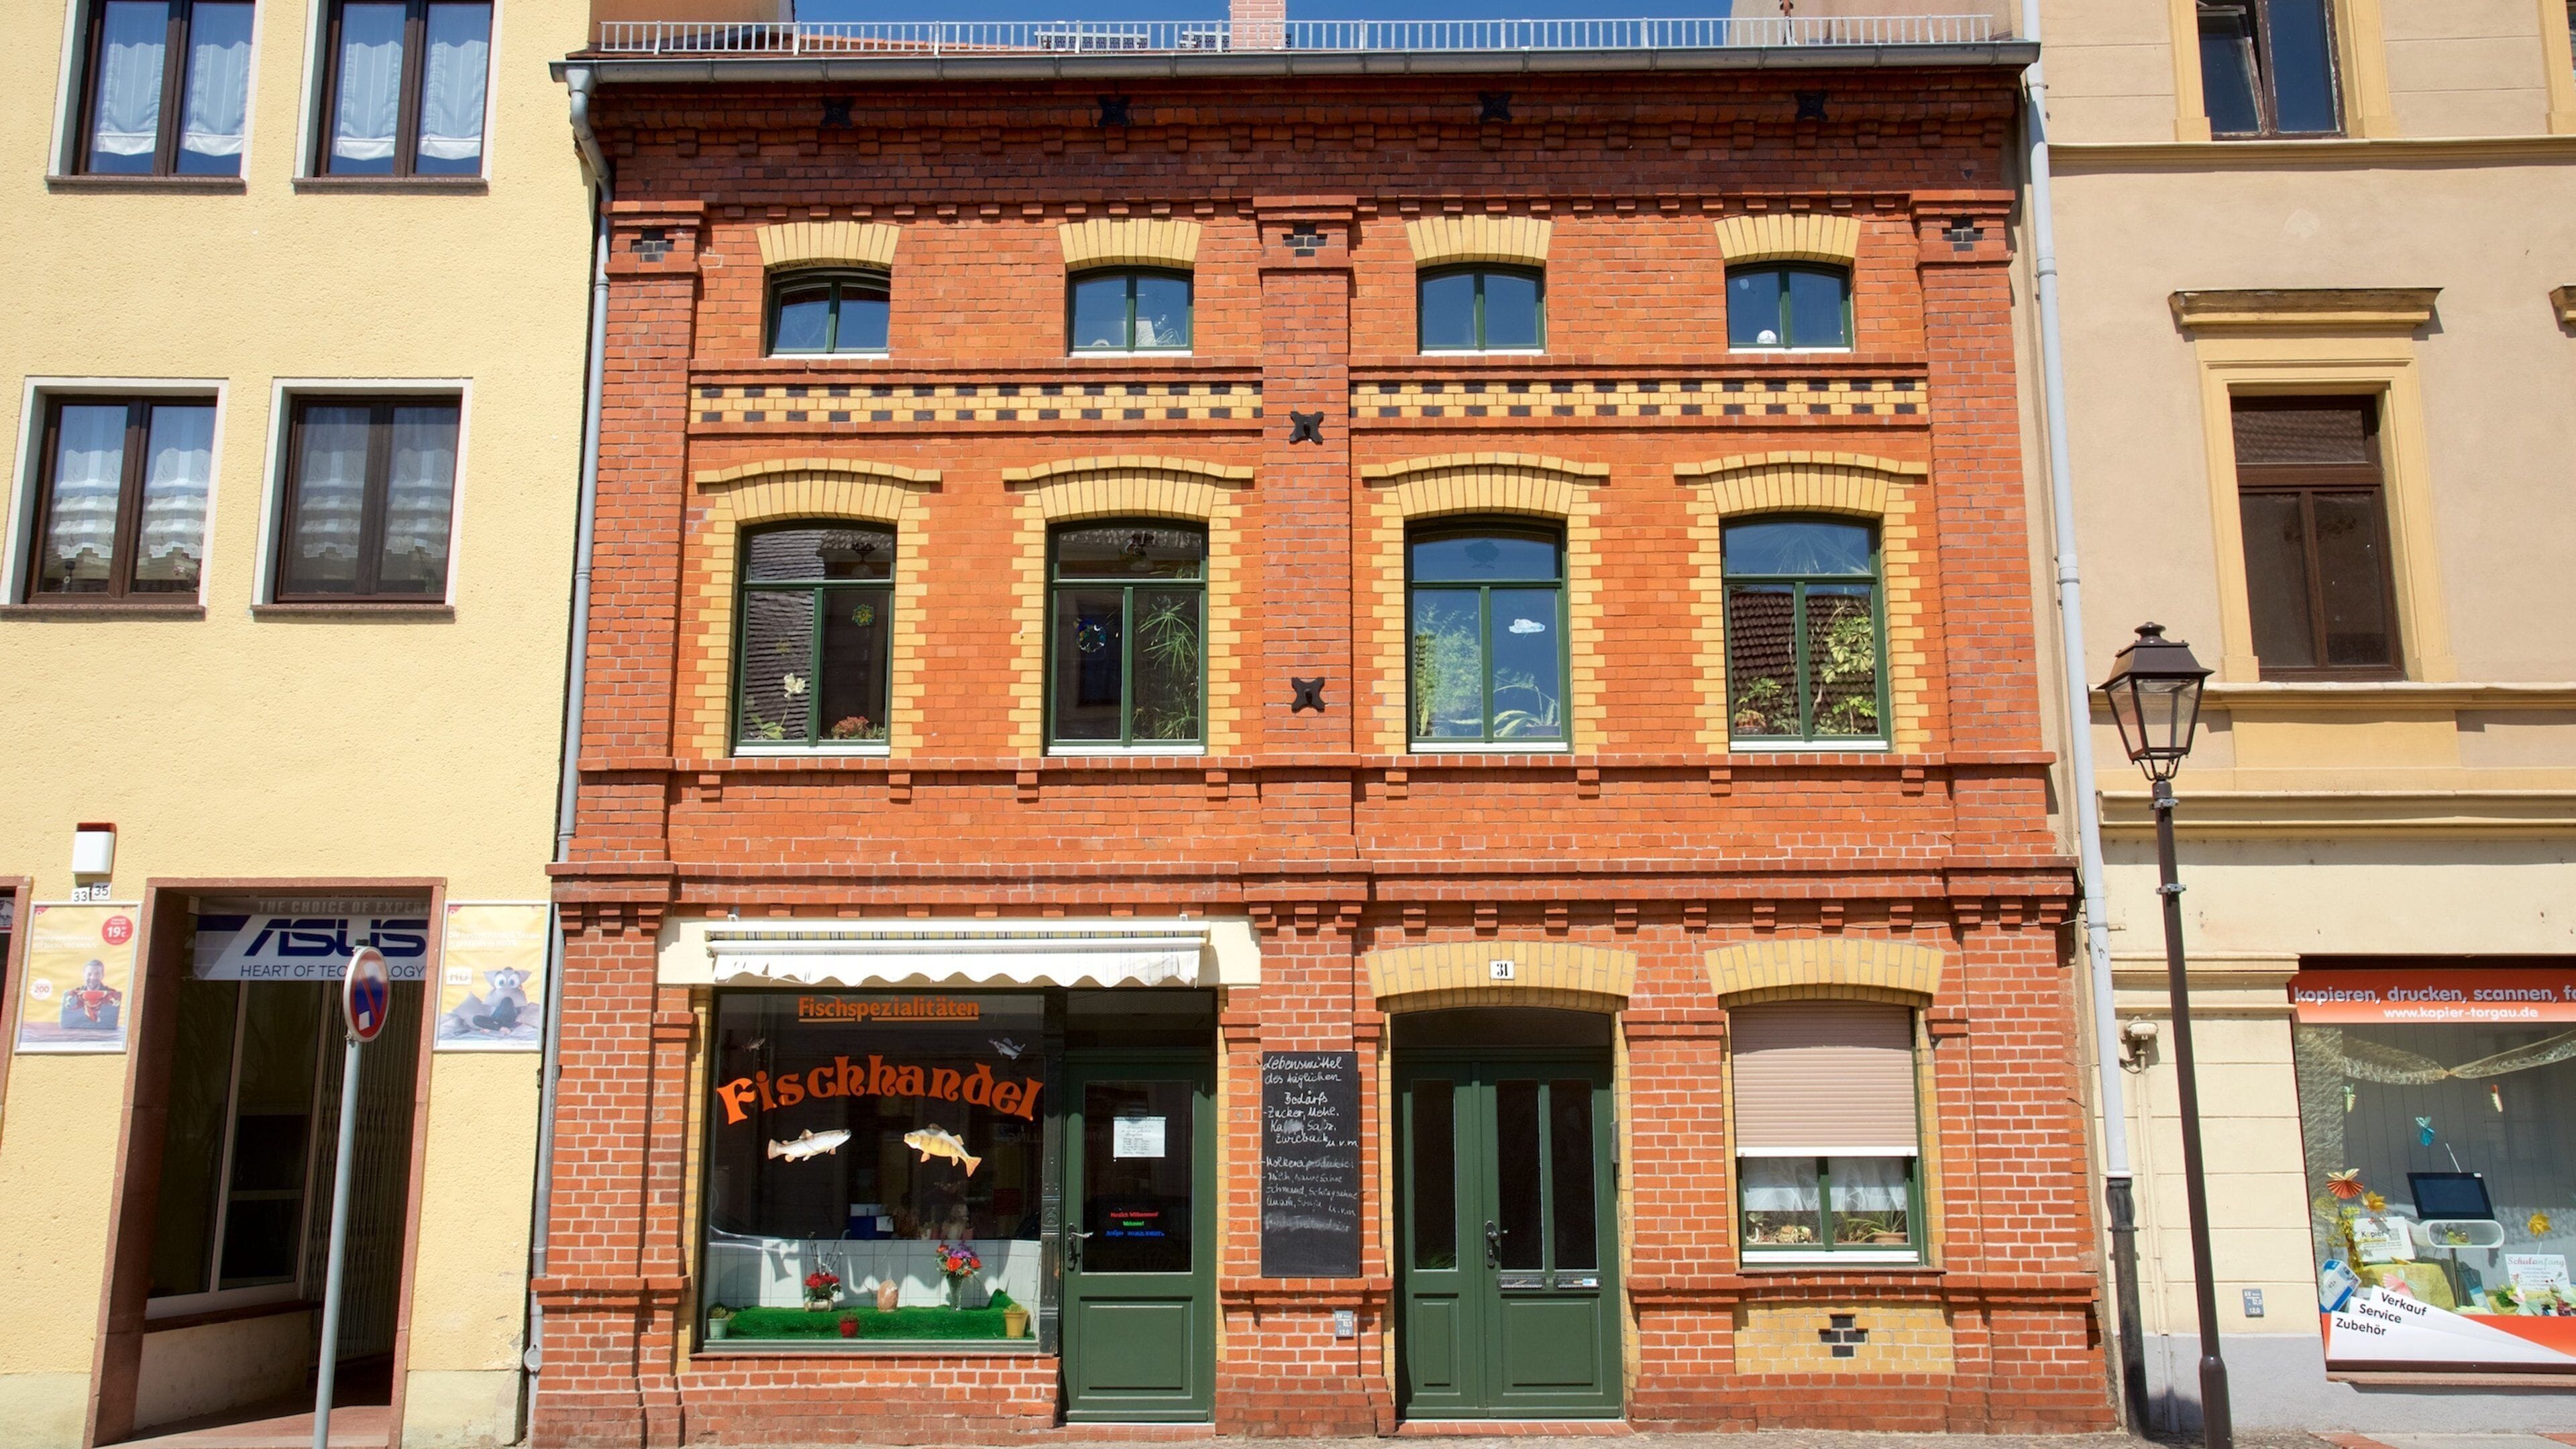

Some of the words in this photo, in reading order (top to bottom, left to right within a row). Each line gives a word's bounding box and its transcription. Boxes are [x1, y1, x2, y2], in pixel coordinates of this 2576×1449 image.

[74, 891, 87, 902] 33
[95, 885, 109, 896] 35
[259, 900, 284, 913] THE
[291, 900, 344, 913] CHOICE
[352, 900, 371, 913] OF
[244, 918, 428, 957] ASUS
[240, 965, 290, 977] HEART
[294, 965, 315, 977] OF
[319, 965, 425, 978] TECOGY
[1497, 963, 1508, 977] 31
[2294, 986, 2381, 1006] kopieren,
[2387, 985, 2467, 1004] drucken,
[2473, 987, 2558, 1004] scannen,
[798, 996, 980, 1021] Fischspezialitäten
[2384, 1006, 2538, 1020] www.kopier-torgau.de
[1263, 1055, 1343, 1071] Lebensmittel
[716, 1055, 1044, 1125] Fischhandel
[1284, 1091, 1328, 1106] Bedarfs
[2508, 1256, 2565, 1267] Schulanfang
[2381, 1291, 2427, 1316] Verkauf
[2359, 1303, 2402, 1324] Service
[2336, 1317, 2387, 1336] Zubehör
